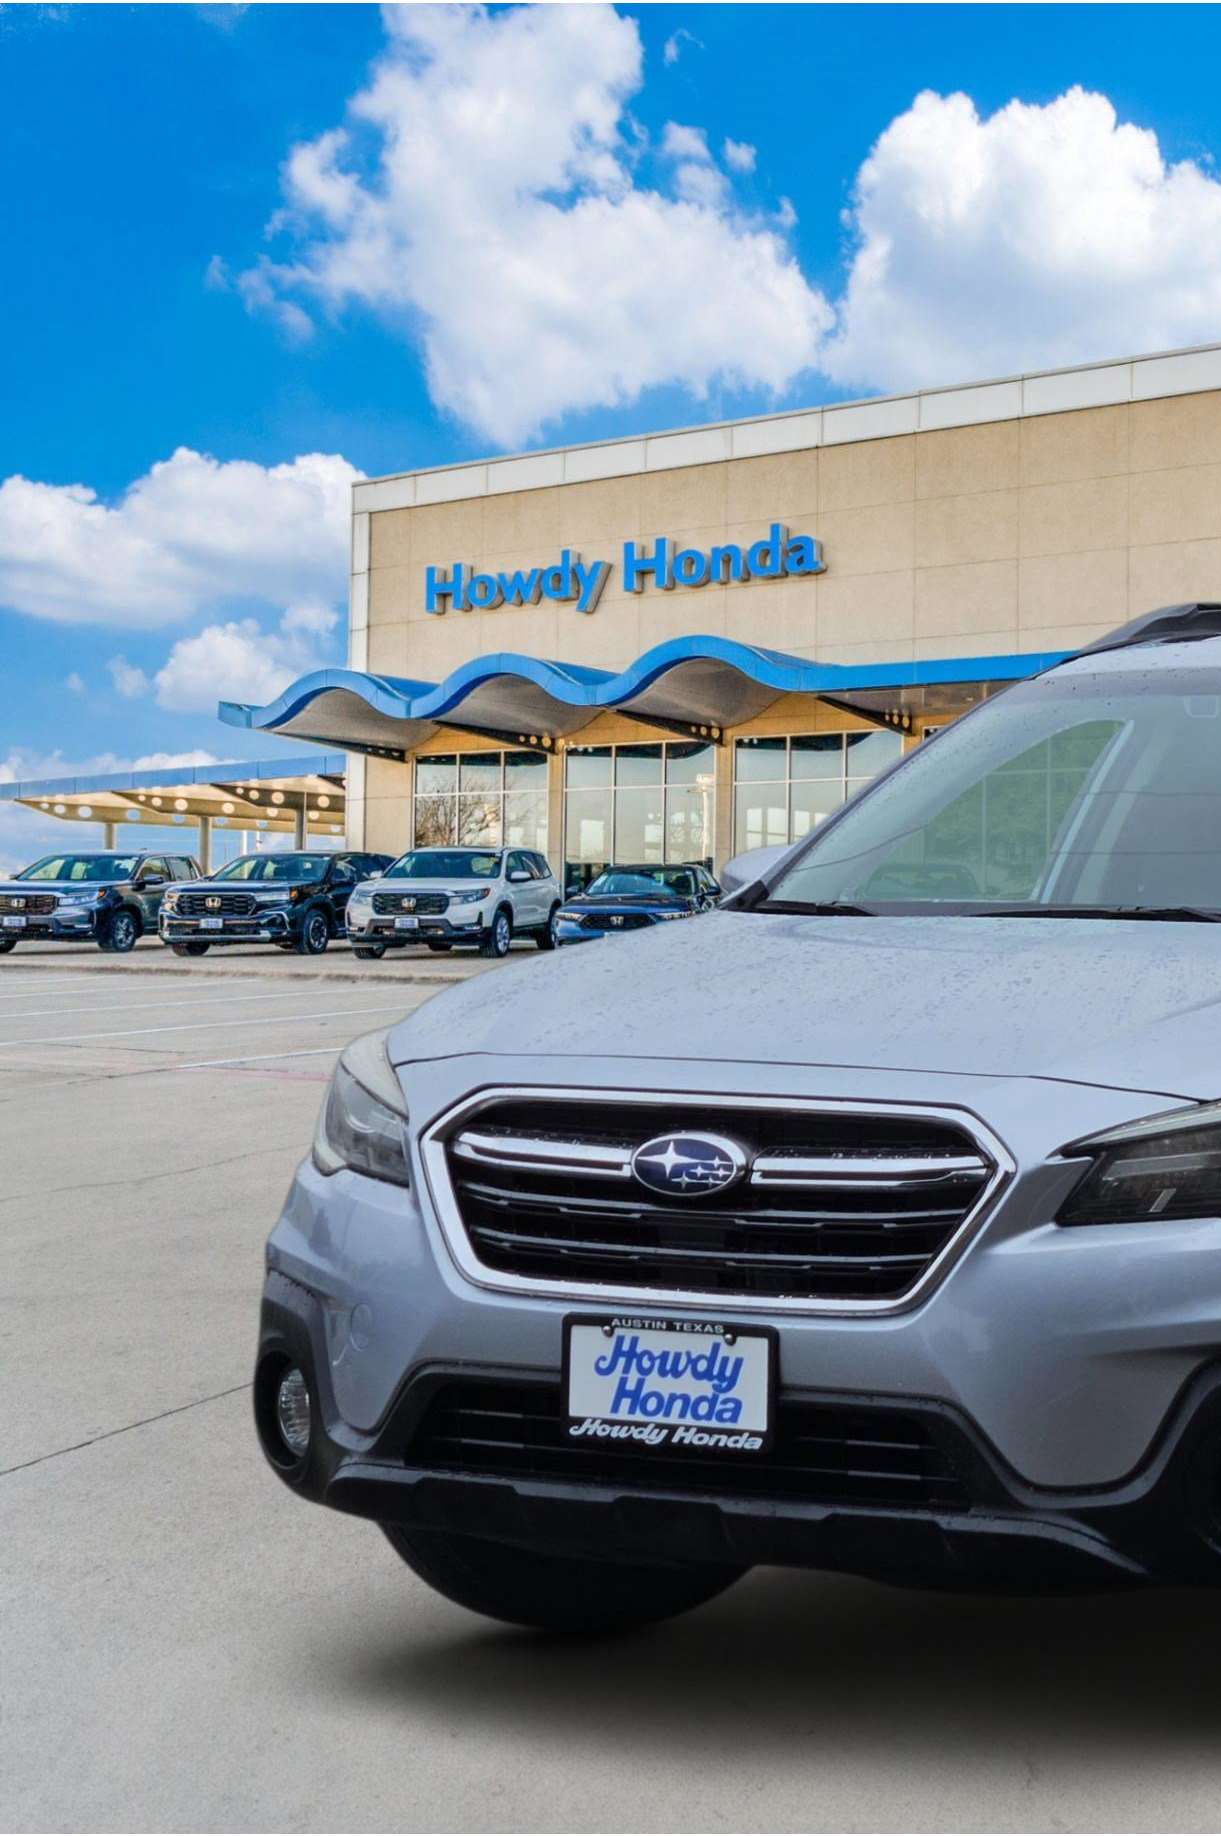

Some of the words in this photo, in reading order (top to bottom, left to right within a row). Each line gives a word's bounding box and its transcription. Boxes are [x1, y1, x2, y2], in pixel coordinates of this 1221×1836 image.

[425, 549, 613, 614] Howdy
[623, 523, 827, 594] Honda
[611, 1318, 667, 1330] AUSTIN
[673, 1321, 725, 1334] TEXAS
[594, 1335, 744, 1393] Howdy
[610, 1376, 743, 1424] Honda
[569, 1418, 670, 1445] Howdy
[672, 1426, 763, 1450] Honda
